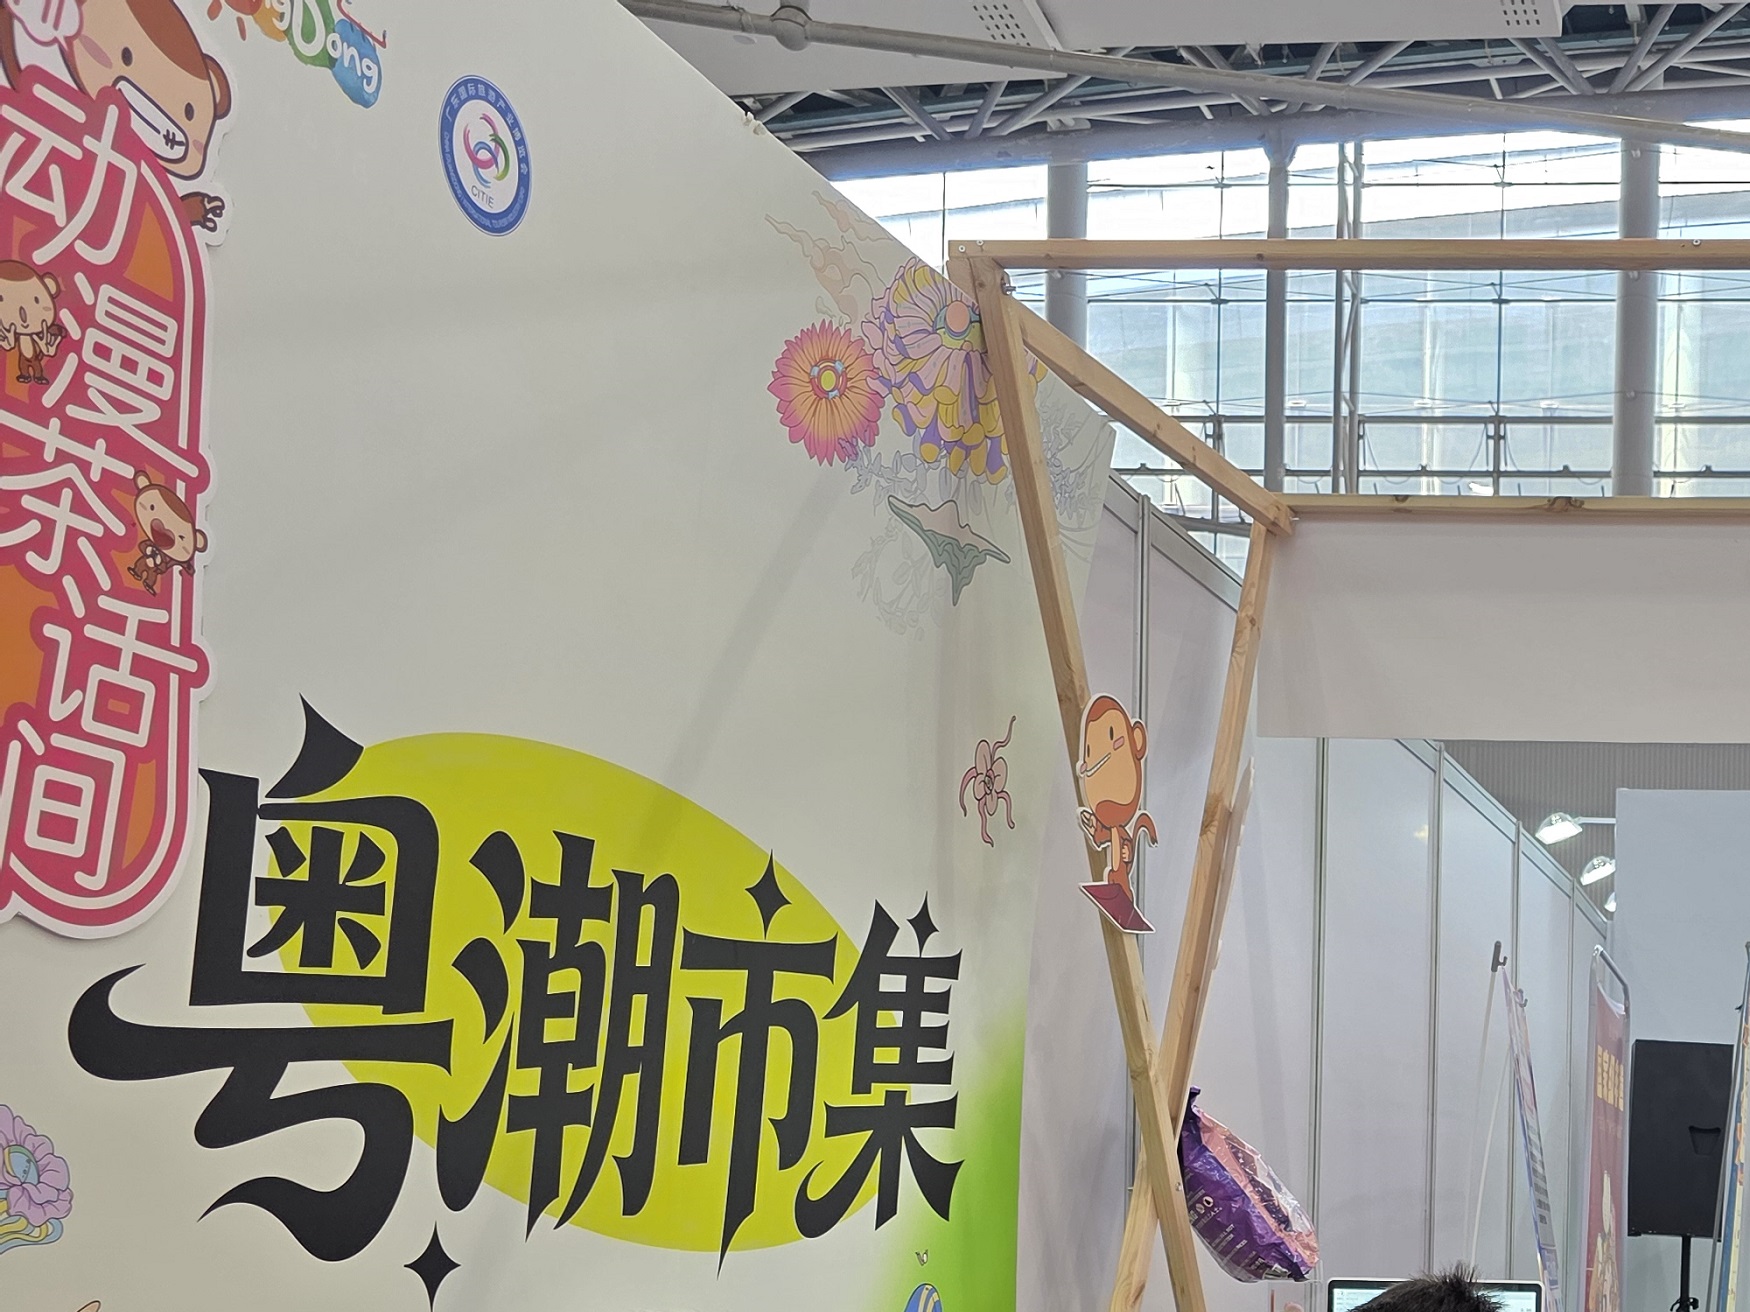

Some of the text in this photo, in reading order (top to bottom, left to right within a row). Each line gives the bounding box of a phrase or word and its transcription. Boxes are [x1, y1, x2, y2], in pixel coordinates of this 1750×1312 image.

[264, 0, 379, 94] gDong
[471, 185, 495, 209] CITIE
[0, 82, 199, 891] 动漫茶话间
[68, 693, 963, 1277] 粤潮市集
